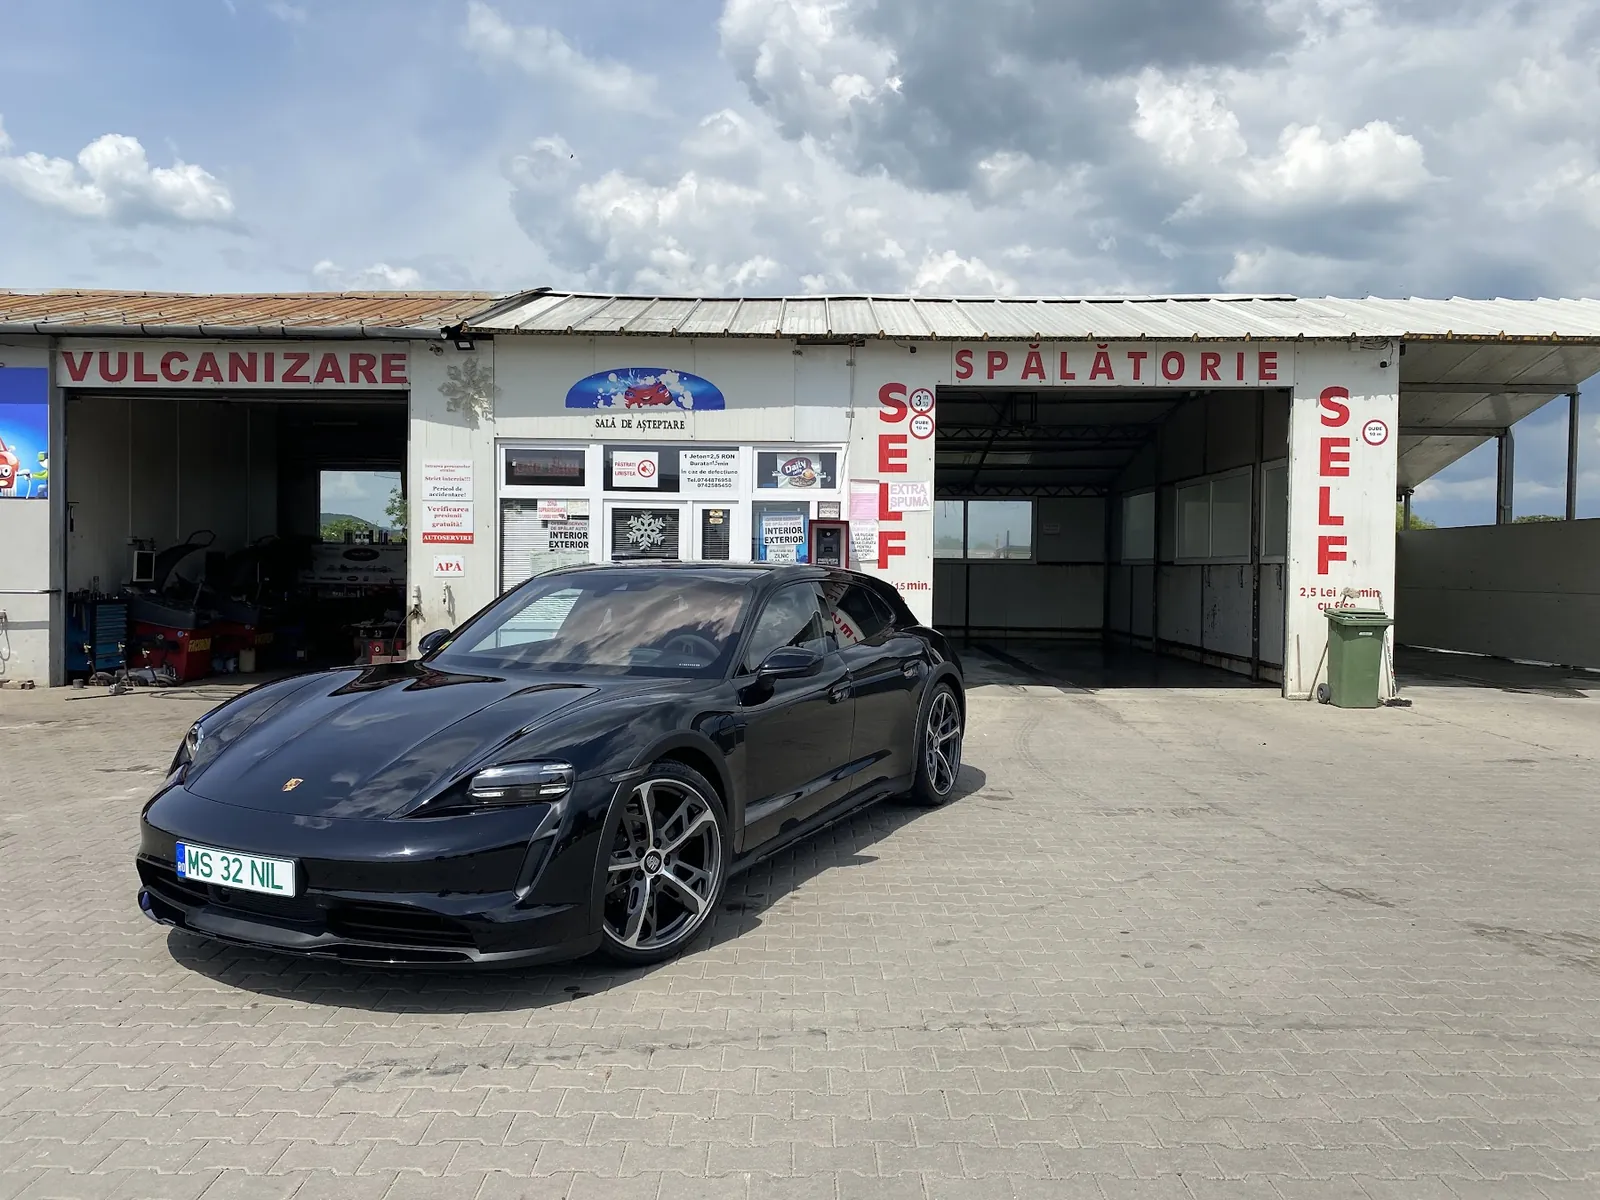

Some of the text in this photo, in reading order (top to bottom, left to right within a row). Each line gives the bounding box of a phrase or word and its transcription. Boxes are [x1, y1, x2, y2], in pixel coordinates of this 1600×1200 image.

[63, 351, 408, 384] VULCANIZARE
[954, 343, 1278, 381] SPĂLĂTORIE
[595, 417, 685, 433] SALĂ DE AȘTEPTARE
[877, 382, 908, 570] SELF
[1317, 386, 1351, 575] SELF
[890, 484, 927, 495] EXTRA
[549, 531, 588, 539] INTERIOR
[764, 526, 803, 535] INTERIOR
[548, 540, 589, 549] EXTERIOR
[764, 535, 804, 544] EXTERIOR
[435, 560, 463, 572] APĂ
[907, 580, 931, 590] min.
[1299, 587, 1317, 598] 2,5
[1320, 587, 1336, 597] Lei
[177, 861, 186, 873] RO
[187, 849, 284, 891] MS 32 NIL
